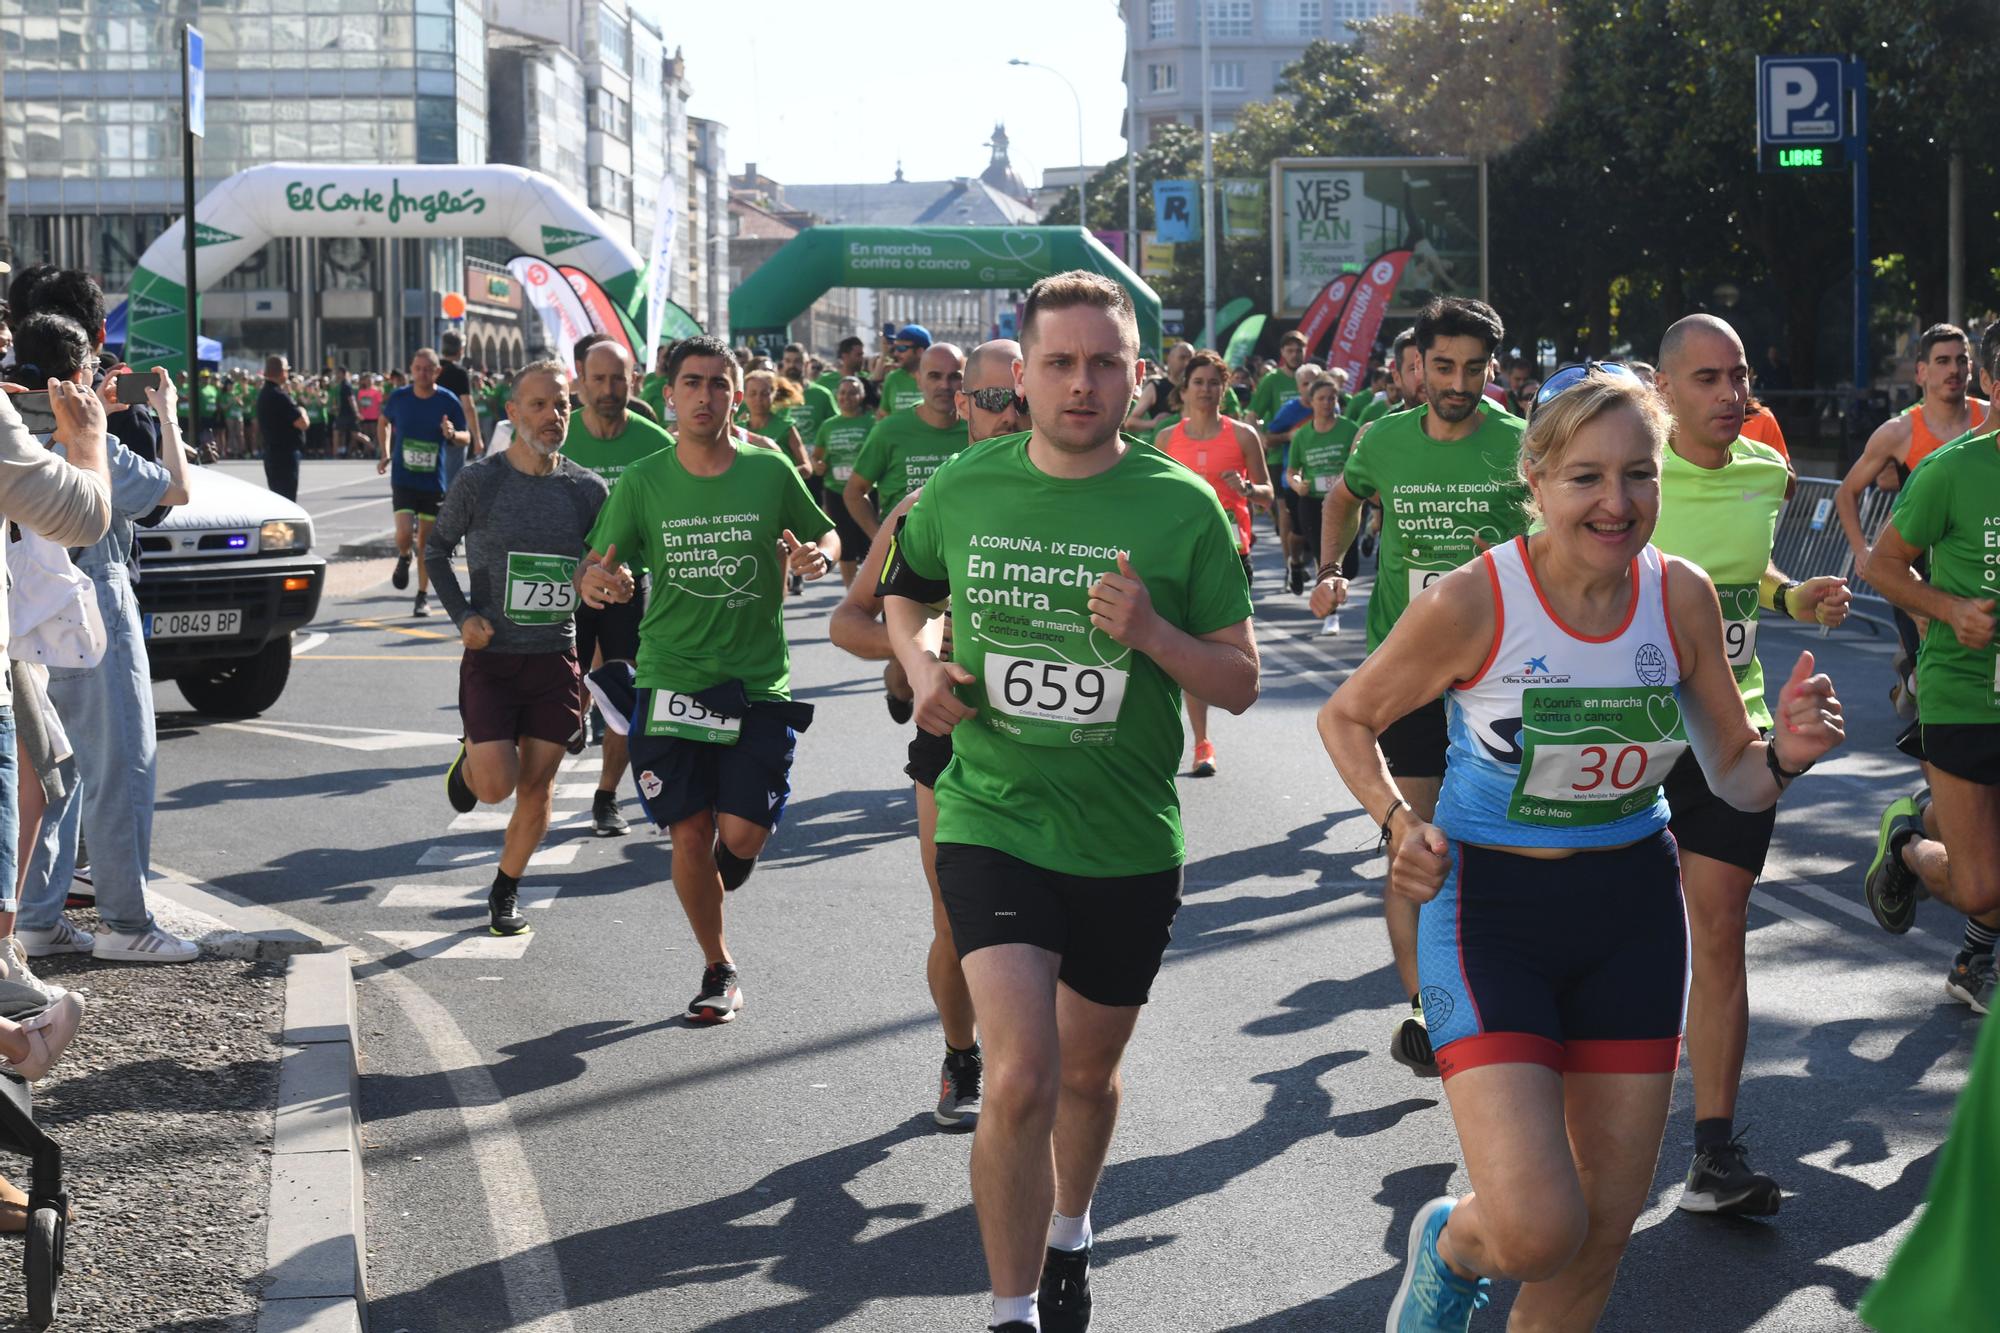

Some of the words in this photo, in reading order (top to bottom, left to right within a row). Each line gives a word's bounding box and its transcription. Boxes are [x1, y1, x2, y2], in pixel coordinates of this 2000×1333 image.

[1770, 67, 1818, 135] P
[1780, 149, 1823, 166] LIBRE
[1297, 179, 1351, 201] YES
[286, 182, 314, 211] El
[317, 183, 384, 212] Corte
[388, 178, 486, 223] Inglés
[1297, 200, 1341, 221] WE
[1298, 221, 1350, 241] FAN
[850, 242, 871, 256] En
[873, 243, 932, 256] marcha
[850, 257, 900, 269] contra
[904, 259, 914, 269] o
[917, 258, 971, 270] cancro
[906, 464, 921, 476] En
[1393, 485, 1399, 494] A
[1400, 483, 1441, 494] CORUÑA
[1446, 484, 1456, 493] IX
[1458, 482, 1500, 493] EDICIÓN
[1393, 498, 1414, 513] En
[1419, 497, 1490, 513] marcha
[661, 520, 668, 529] A
[668, 515, 708, 528] CORUÑA
[712, 515, 722, 524] IX
[723, 511, 760, 524] EDICIÓN
[1398, 515, 1454, 531] contra
[1984, 517, 1991, 526] A
[662, 532, 682, 547] En
[686, 527, 753, 546] marcha
[969, 535, 978, 548] A
[980, 535, 1042, 553] CORUÑA
[1051, 542, 1066, 555] IX
[666, 547, 718, 563] contra
[1443, 543, 1470, 551] marcha
[668, 567, 676, 578] o
[679, 564, 737, 579] cancro
[966, 554, 996, 579] En
[1984, 570, 1996, 581] o
[523, 581, 571, 607] 735
[966, 586, 1050, 611] contra
[153, 616, 163, 634] C
[170, 614, 210, 634] 0849
[217, 612, 238, 632] BP
[998, 611, 1030, 625] Coruña
[1031, 619, 1045, 629] en
[1046, 620, 1086, 634] marcha
[988, 624, 1019, 637] contra
[1021, 630, 1028, 638] o
[1029, 630, 1065, 643] cancro
[1004, 660, 1105, 715] 659
[1502, 676, 1520, 684] Obra
[1521, 676, 1541, 684] Social
[1533, 697, 1541, 708] A
[1543, 696, 1582, 709] Coruña
[1584, 699, 1599, 708] en
[1601, 696, 1643, 709] marcha
[1534, 711, 1571, 722] contra
[1574, 714, 1581, 722] o
[1584, 713, 1623, 722] cancro
[1571, 745, 1648, 791] 30
[1519, 805, 1531, 816] 29
[1533, 806, 1546, 817] de
[1548, 808, 1572, 819] Maio
